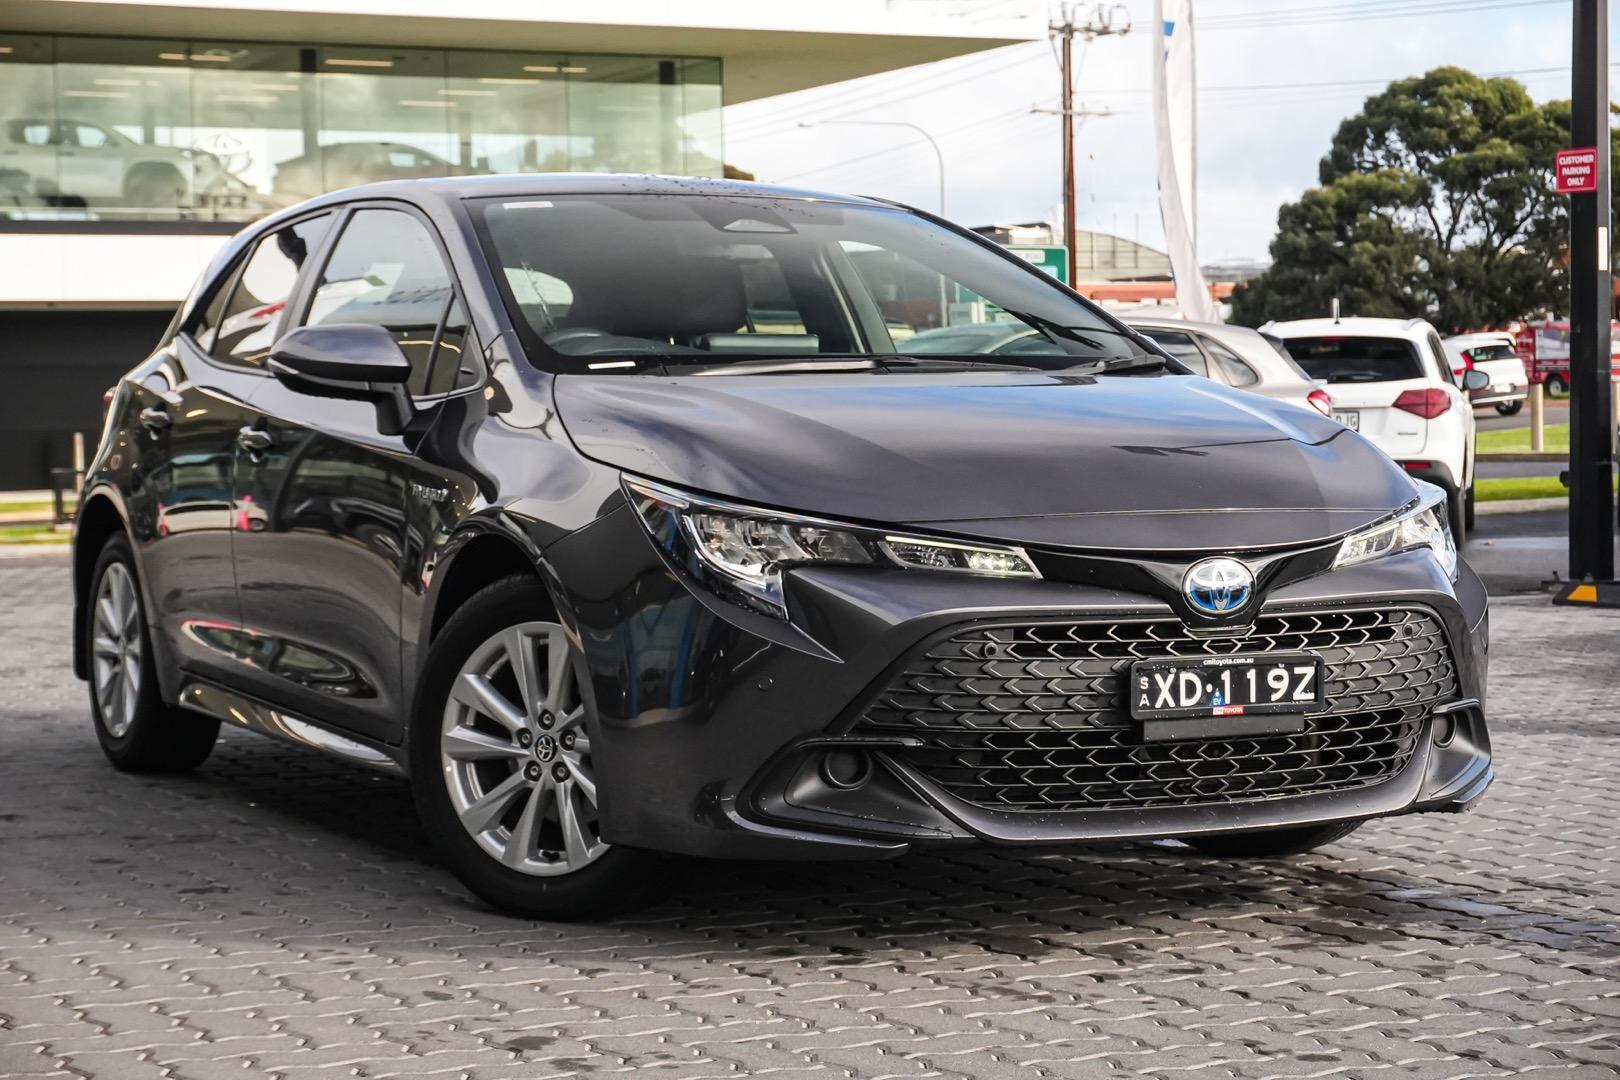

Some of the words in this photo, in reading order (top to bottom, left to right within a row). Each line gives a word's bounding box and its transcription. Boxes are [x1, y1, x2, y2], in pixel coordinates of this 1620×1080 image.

[1559, 154, 1594, 165] CUSTOMER
[1562, 166, 1590, 176] PARKING
[1567, 177, 1585, 186] ONLY
